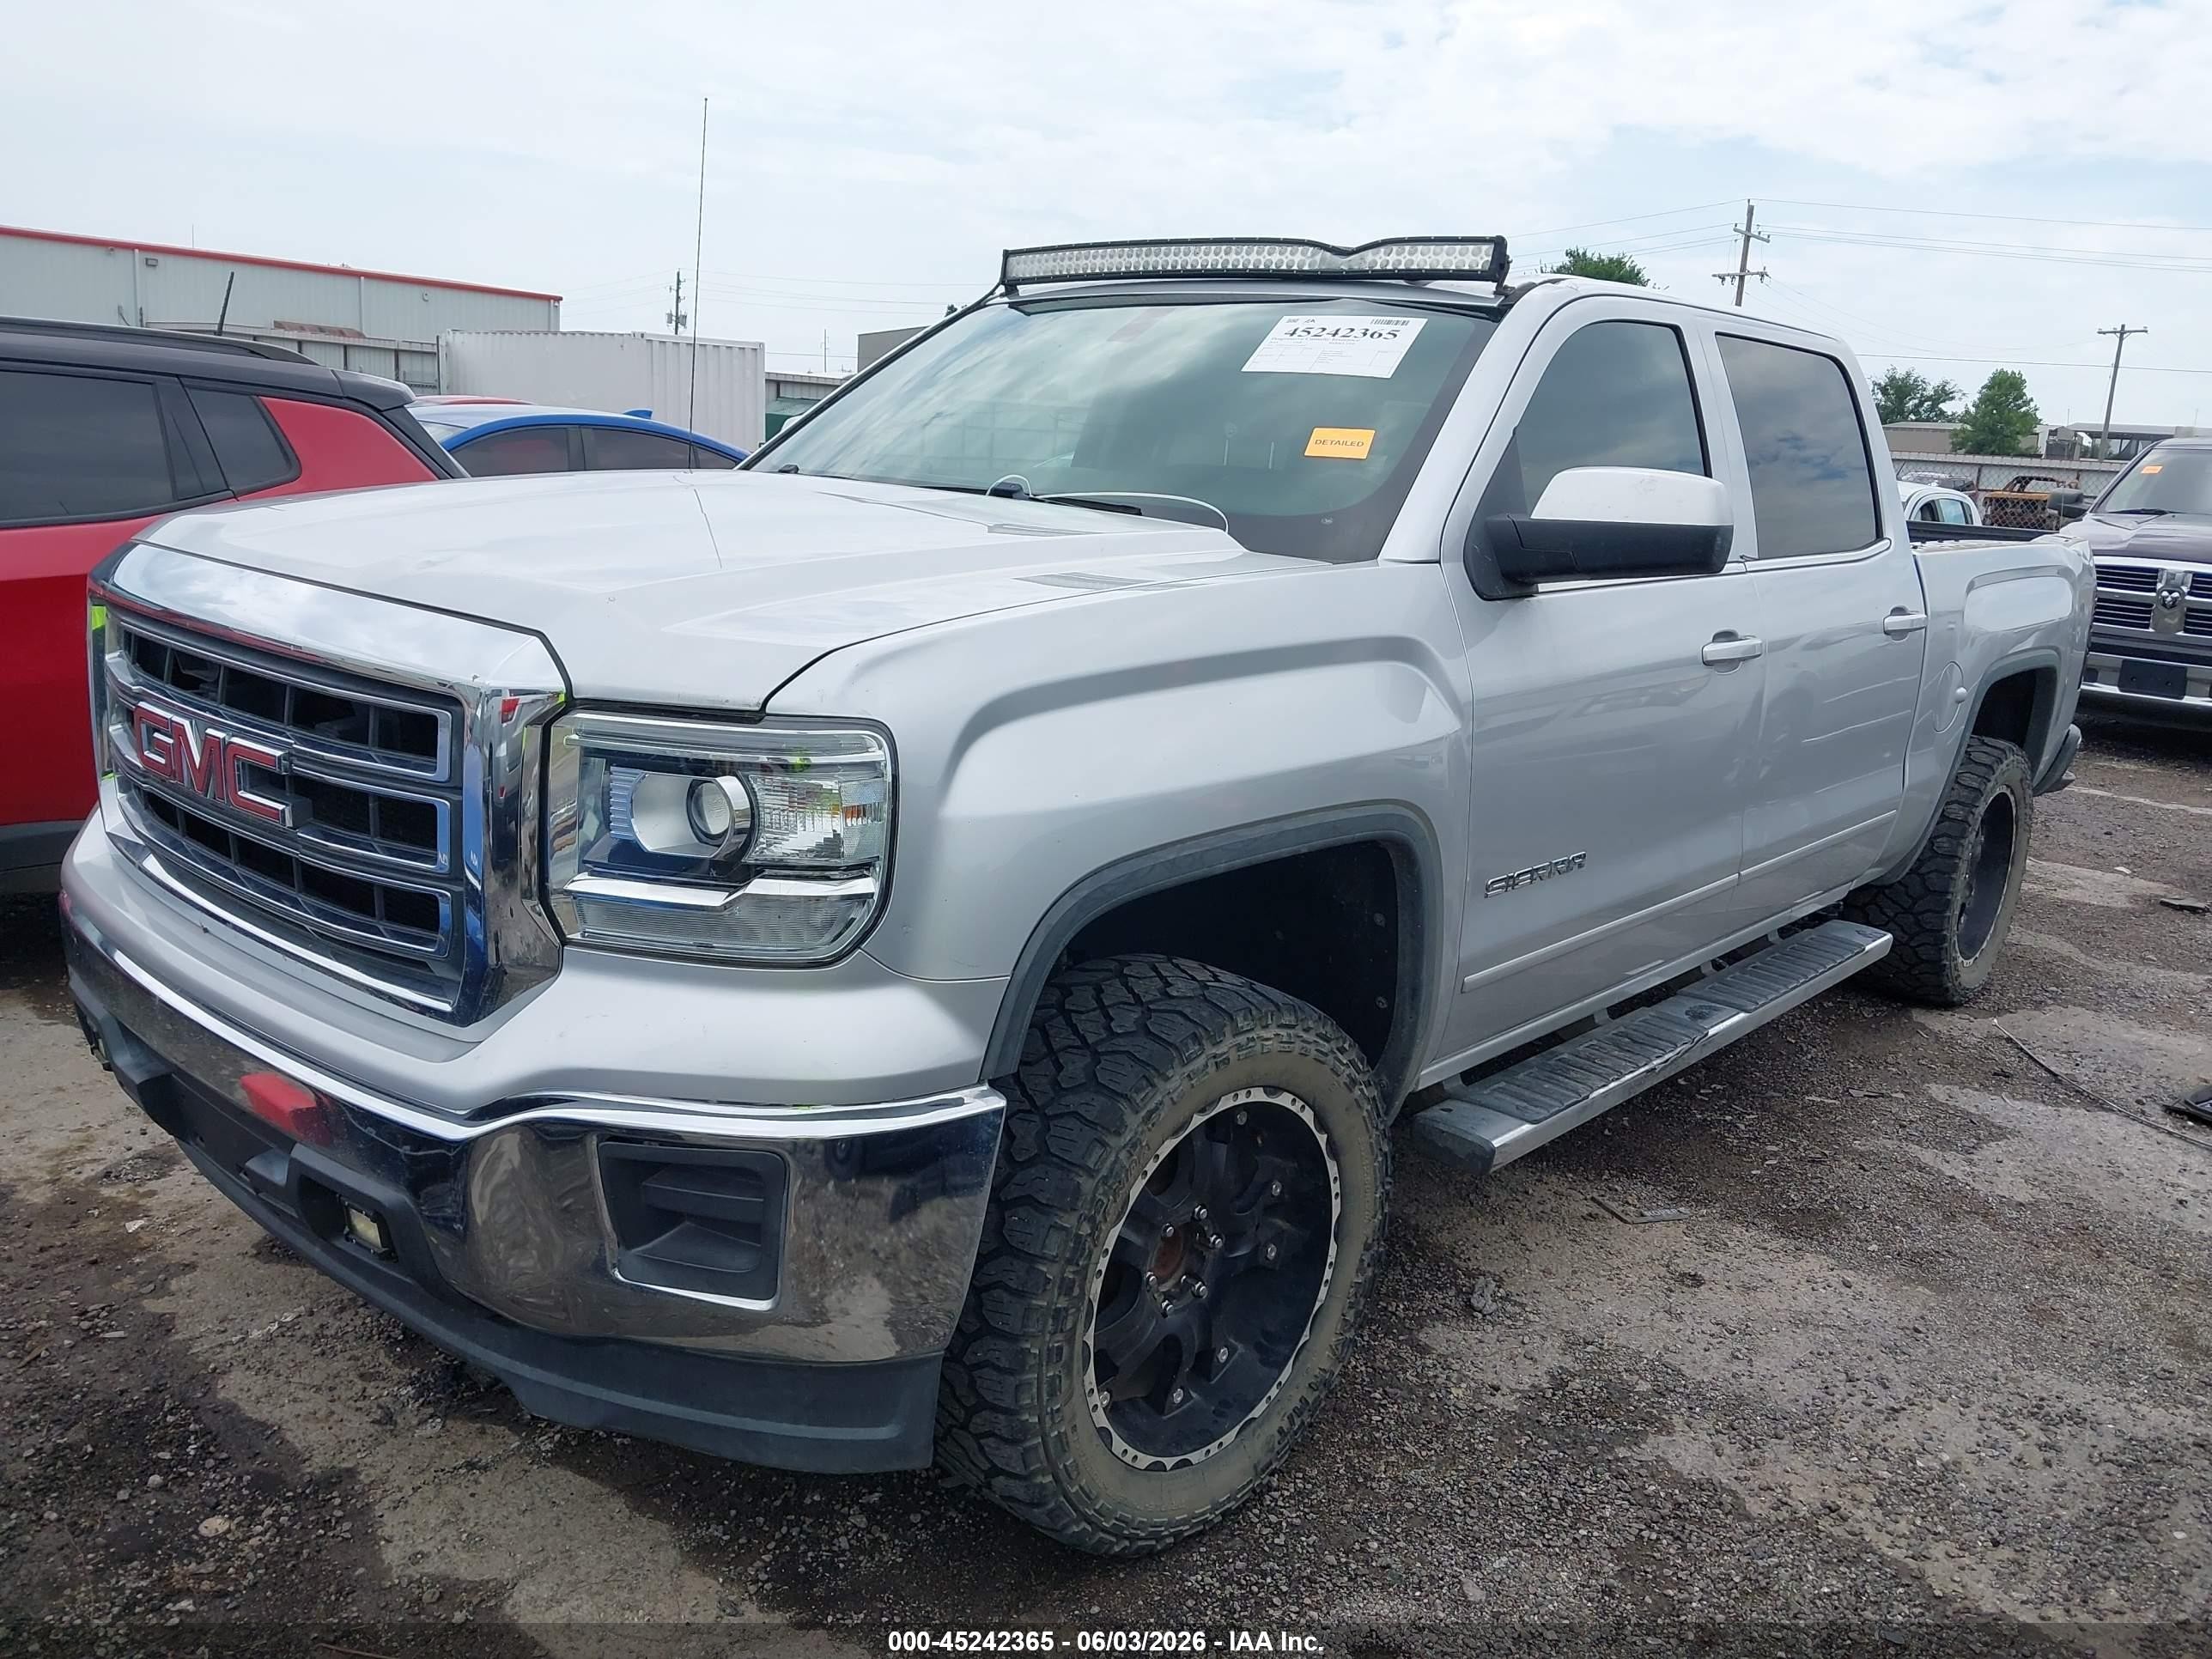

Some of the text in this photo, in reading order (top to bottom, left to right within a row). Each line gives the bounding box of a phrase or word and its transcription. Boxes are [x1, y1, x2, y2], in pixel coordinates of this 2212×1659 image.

[1284, 326, 1401, 340] 45242365
[1314, 439, 1364, 447] DETAILED
[132, 700, 293, 828] GMC
[1484, 851, 1587, 898] SIERRA
